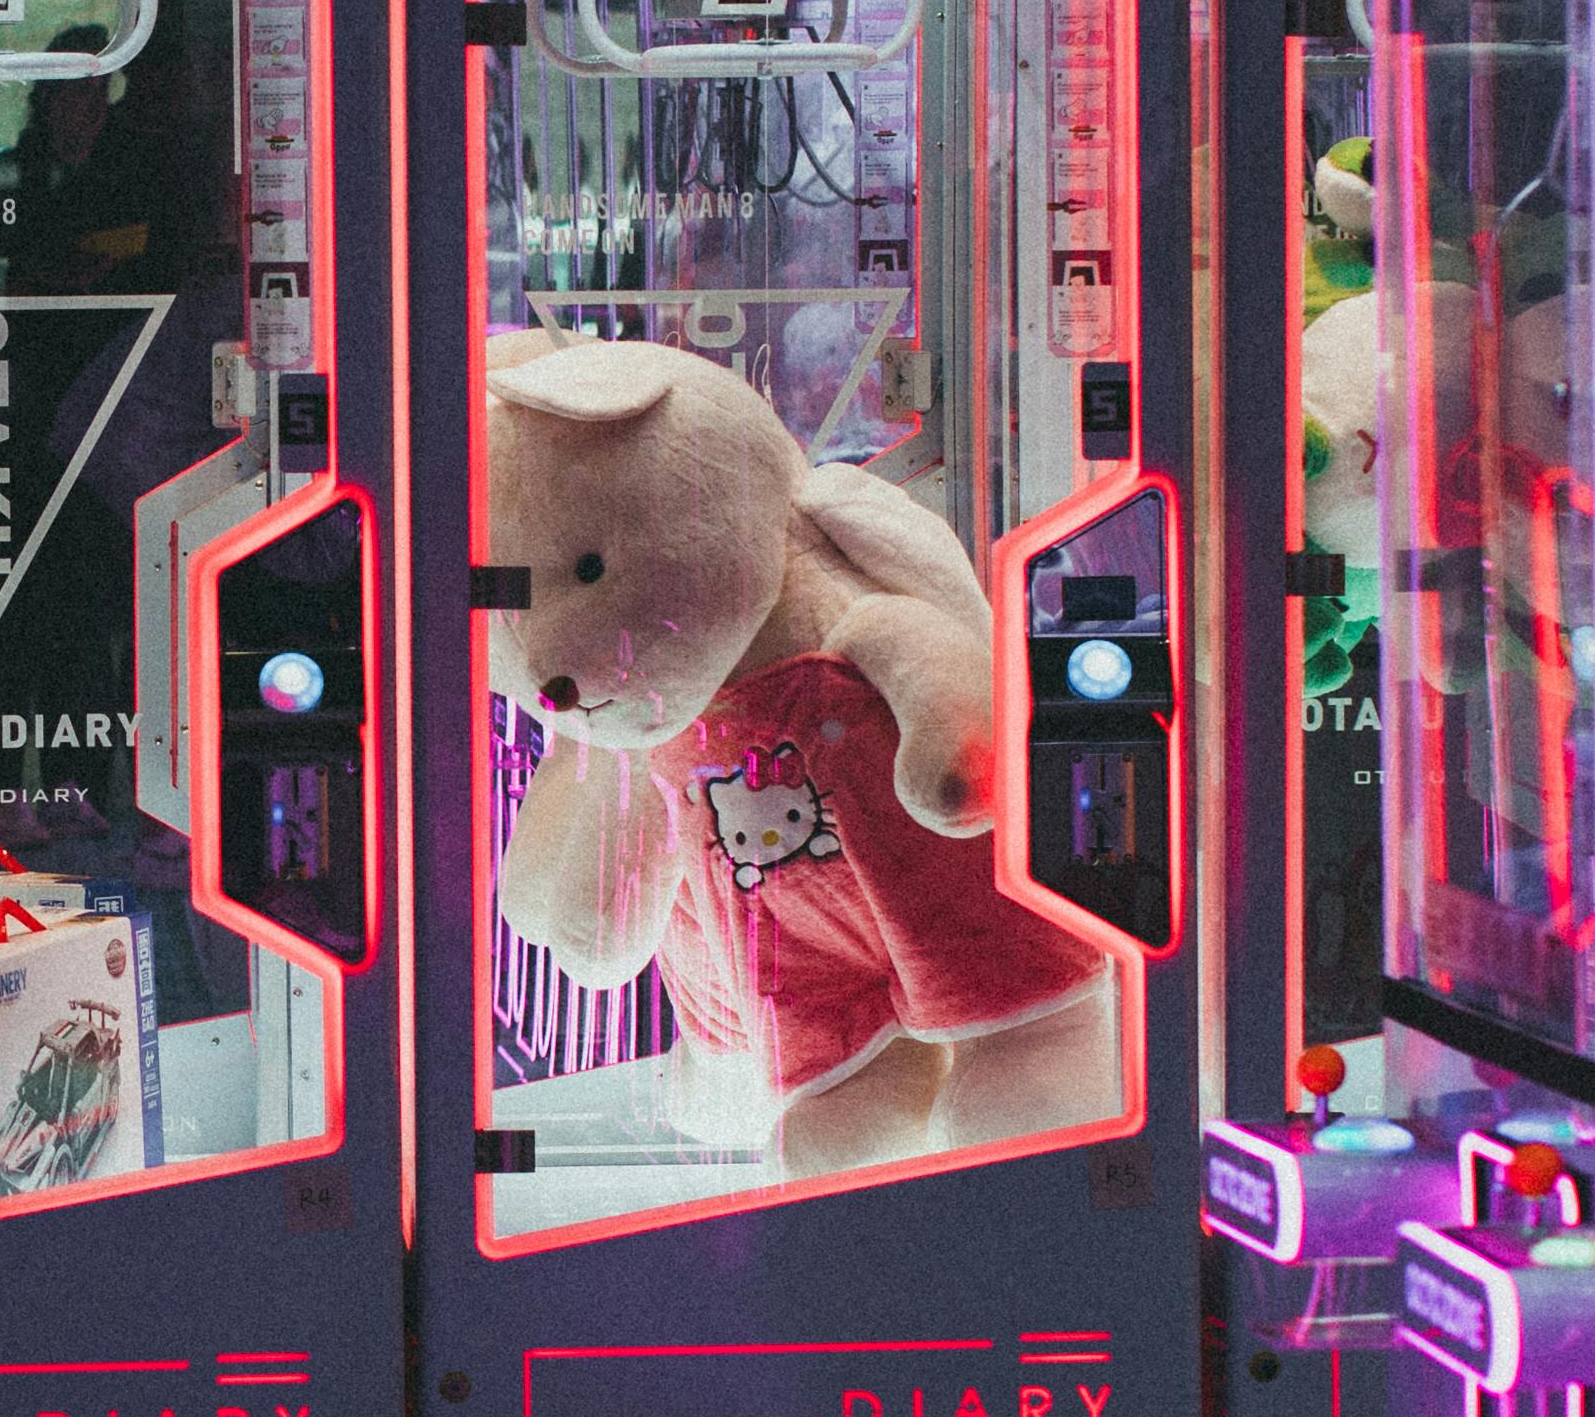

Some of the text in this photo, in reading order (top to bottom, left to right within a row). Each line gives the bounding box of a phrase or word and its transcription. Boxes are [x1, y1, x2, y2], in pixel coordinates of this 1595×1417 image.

[2, 198, 16, 225] 8
[676, 192, 732, 219] MAN
[740, 191, 754, 218] 8
[601, 228, 635, 254] ON
[2, 712, 142, 750] DIARY
[0, 787, 90, 804] DIARY
